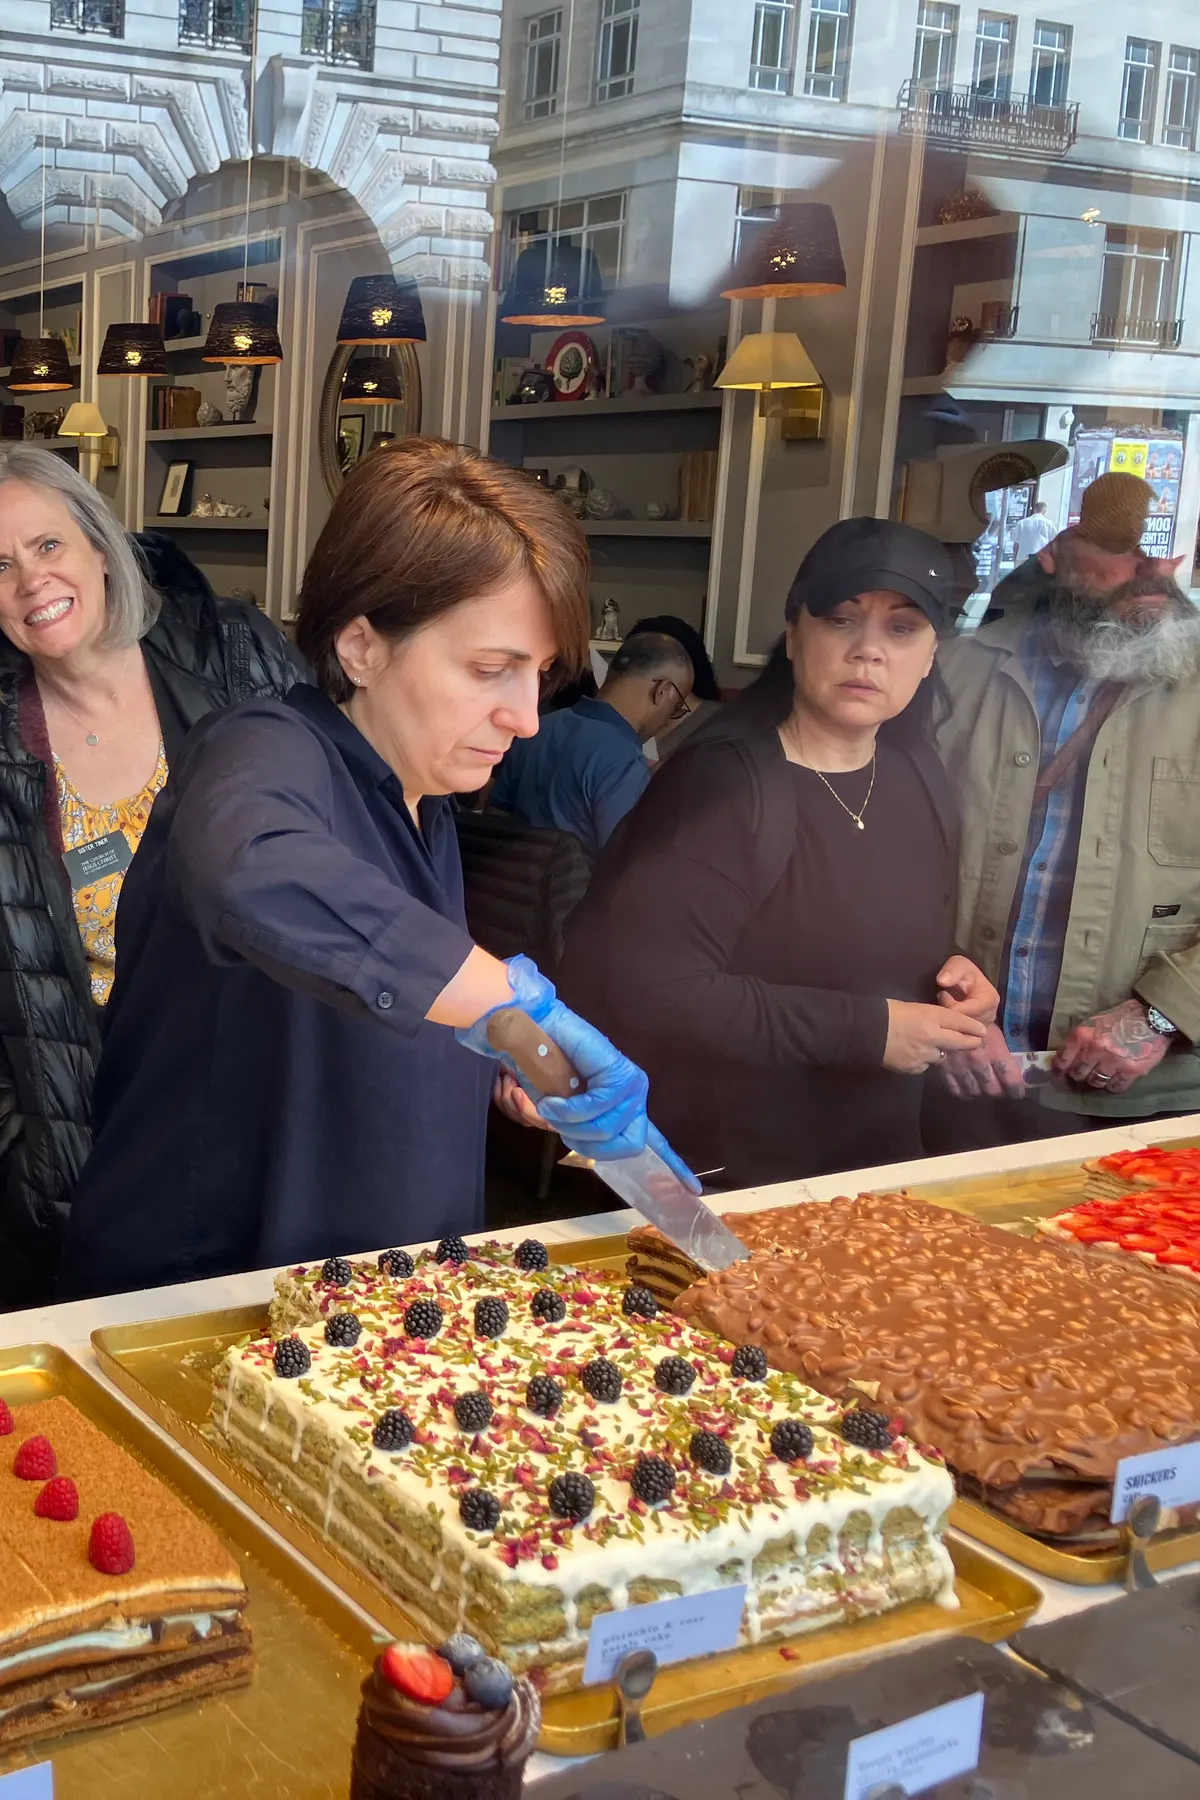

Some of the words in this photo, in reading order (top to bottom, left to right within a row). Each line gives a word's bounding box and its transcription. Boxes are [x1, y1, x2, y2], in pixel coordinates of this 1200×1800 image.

[78, 844, 94, 854] SISTER
[1125, 1467, 1178, 1491] SNICKERS
[603, 1624, 658, 1645] pistachio
[664, 1620, 673, 1629] &
[679, 1615, 707, 1627] rose
[644, 1631, 671, 1644] cake
